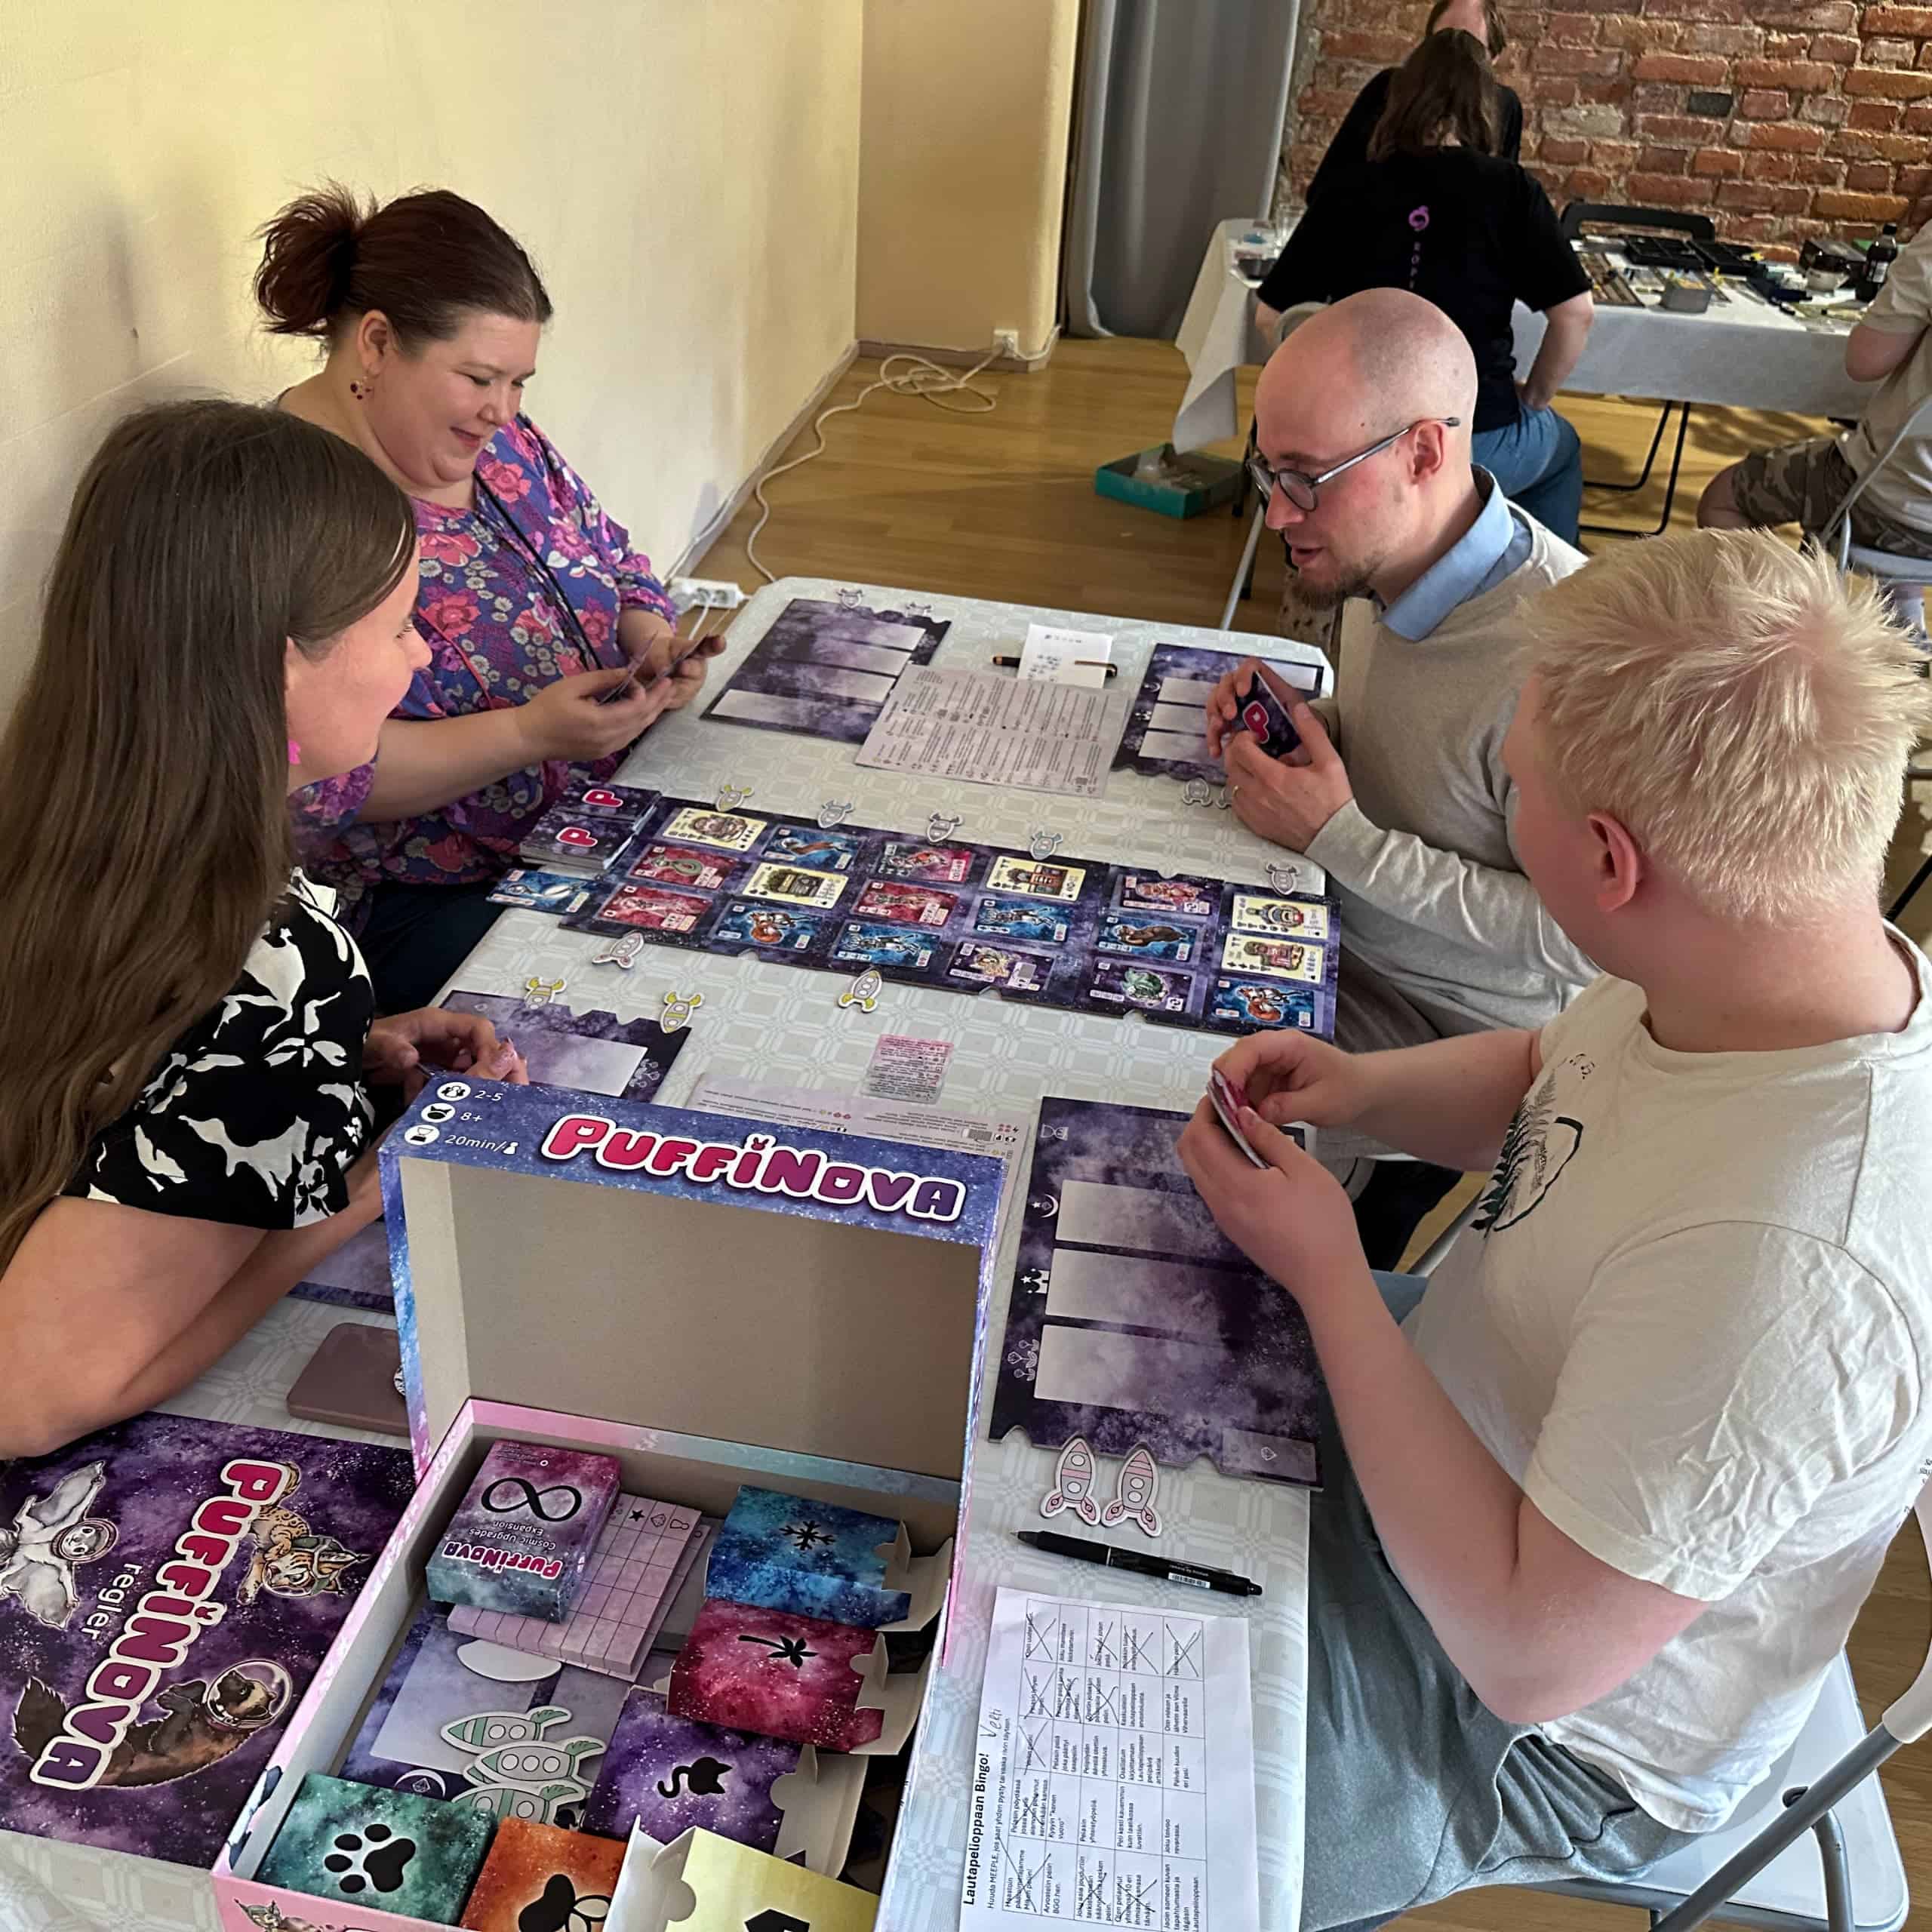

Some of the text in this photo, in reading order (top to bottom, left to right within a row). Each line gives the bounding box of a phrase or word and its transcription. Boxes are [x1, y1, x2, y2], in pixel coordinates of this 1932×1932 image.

[582, 789, 623, 808] P
[555, 826, 598, 847] P
[474, 1090, 503, 1102] 2-5
[460, 1112, 483, 1122] 8+
[469, 1527, 556, 1550] Cosmic Upgrades
[493, 1521, 544, 1537] Expansion
[82, 1563, 143, 1639] regler
[1013, 1779, 1022, 1809] pöydässä
[995, 1804, 1003, 1825] yhden
[963, 1752, 990, 1905] Lautapelioppaan Bingo!
[1048, 1817, 1056, 1838] Kysyin
[989, 1852, 998, 1882] MEEPLE,
[987, 1884, 995, 1908] Huuda
[1043, 1879, 1051, 1912] Arvostelin
